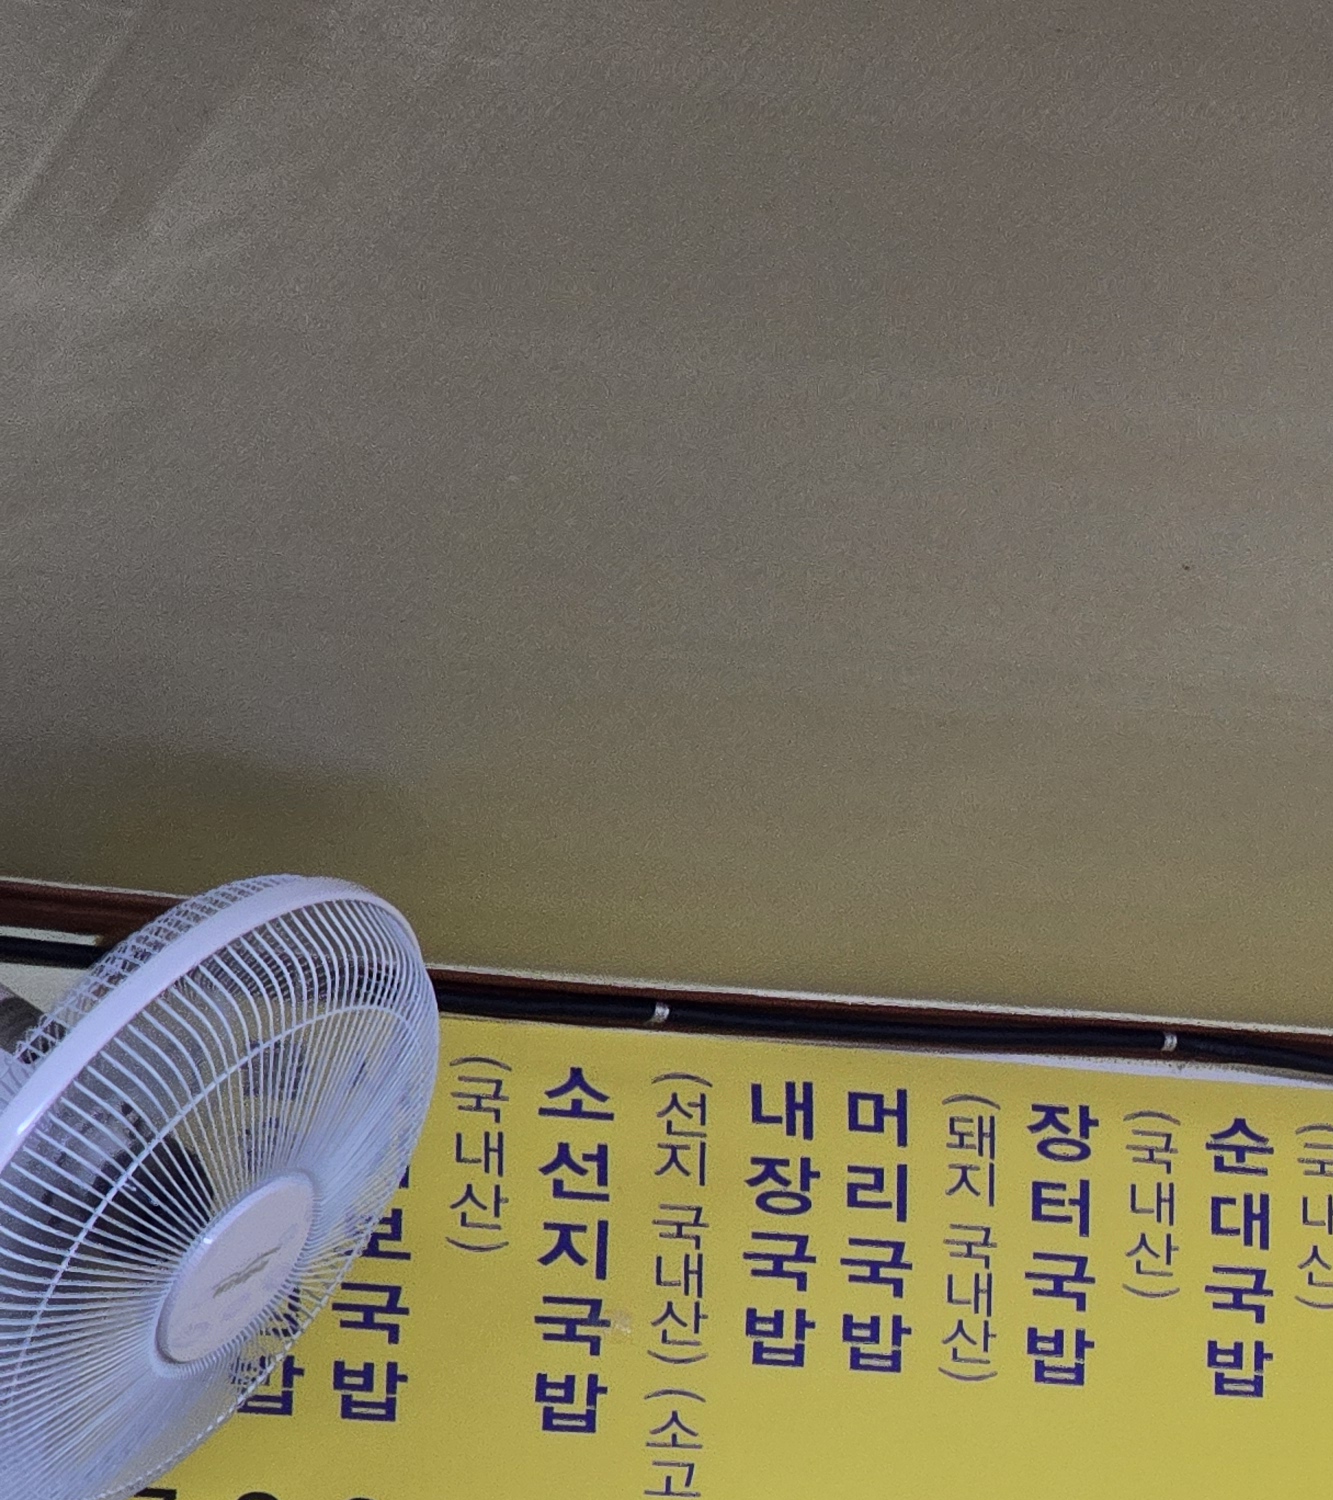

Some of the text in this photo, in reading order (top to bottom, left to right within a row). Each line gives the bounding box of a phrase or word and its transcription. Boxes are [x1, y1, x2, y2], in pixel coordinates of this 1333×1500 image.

[446, 1057, 512, 1252] (국내산)
[534, 1067, 614, 1433] 소선지국밥
[652, 1073, 712, 1186] (선지
[743, 1081, 820, 1367] 내장국밥
[840, 1088, 912, 1373] 머리국밥
[939, 1094, 1000, 1381] (돼지 국내산)
[1025, 1103, 1099, 1386] 장터국밥
[1124, 1111, 1180, 1297] (국내산)
[1205, 1117, 1274, 1397] 순대국밥
[648, 1204, 709, 1364] 국내산)
